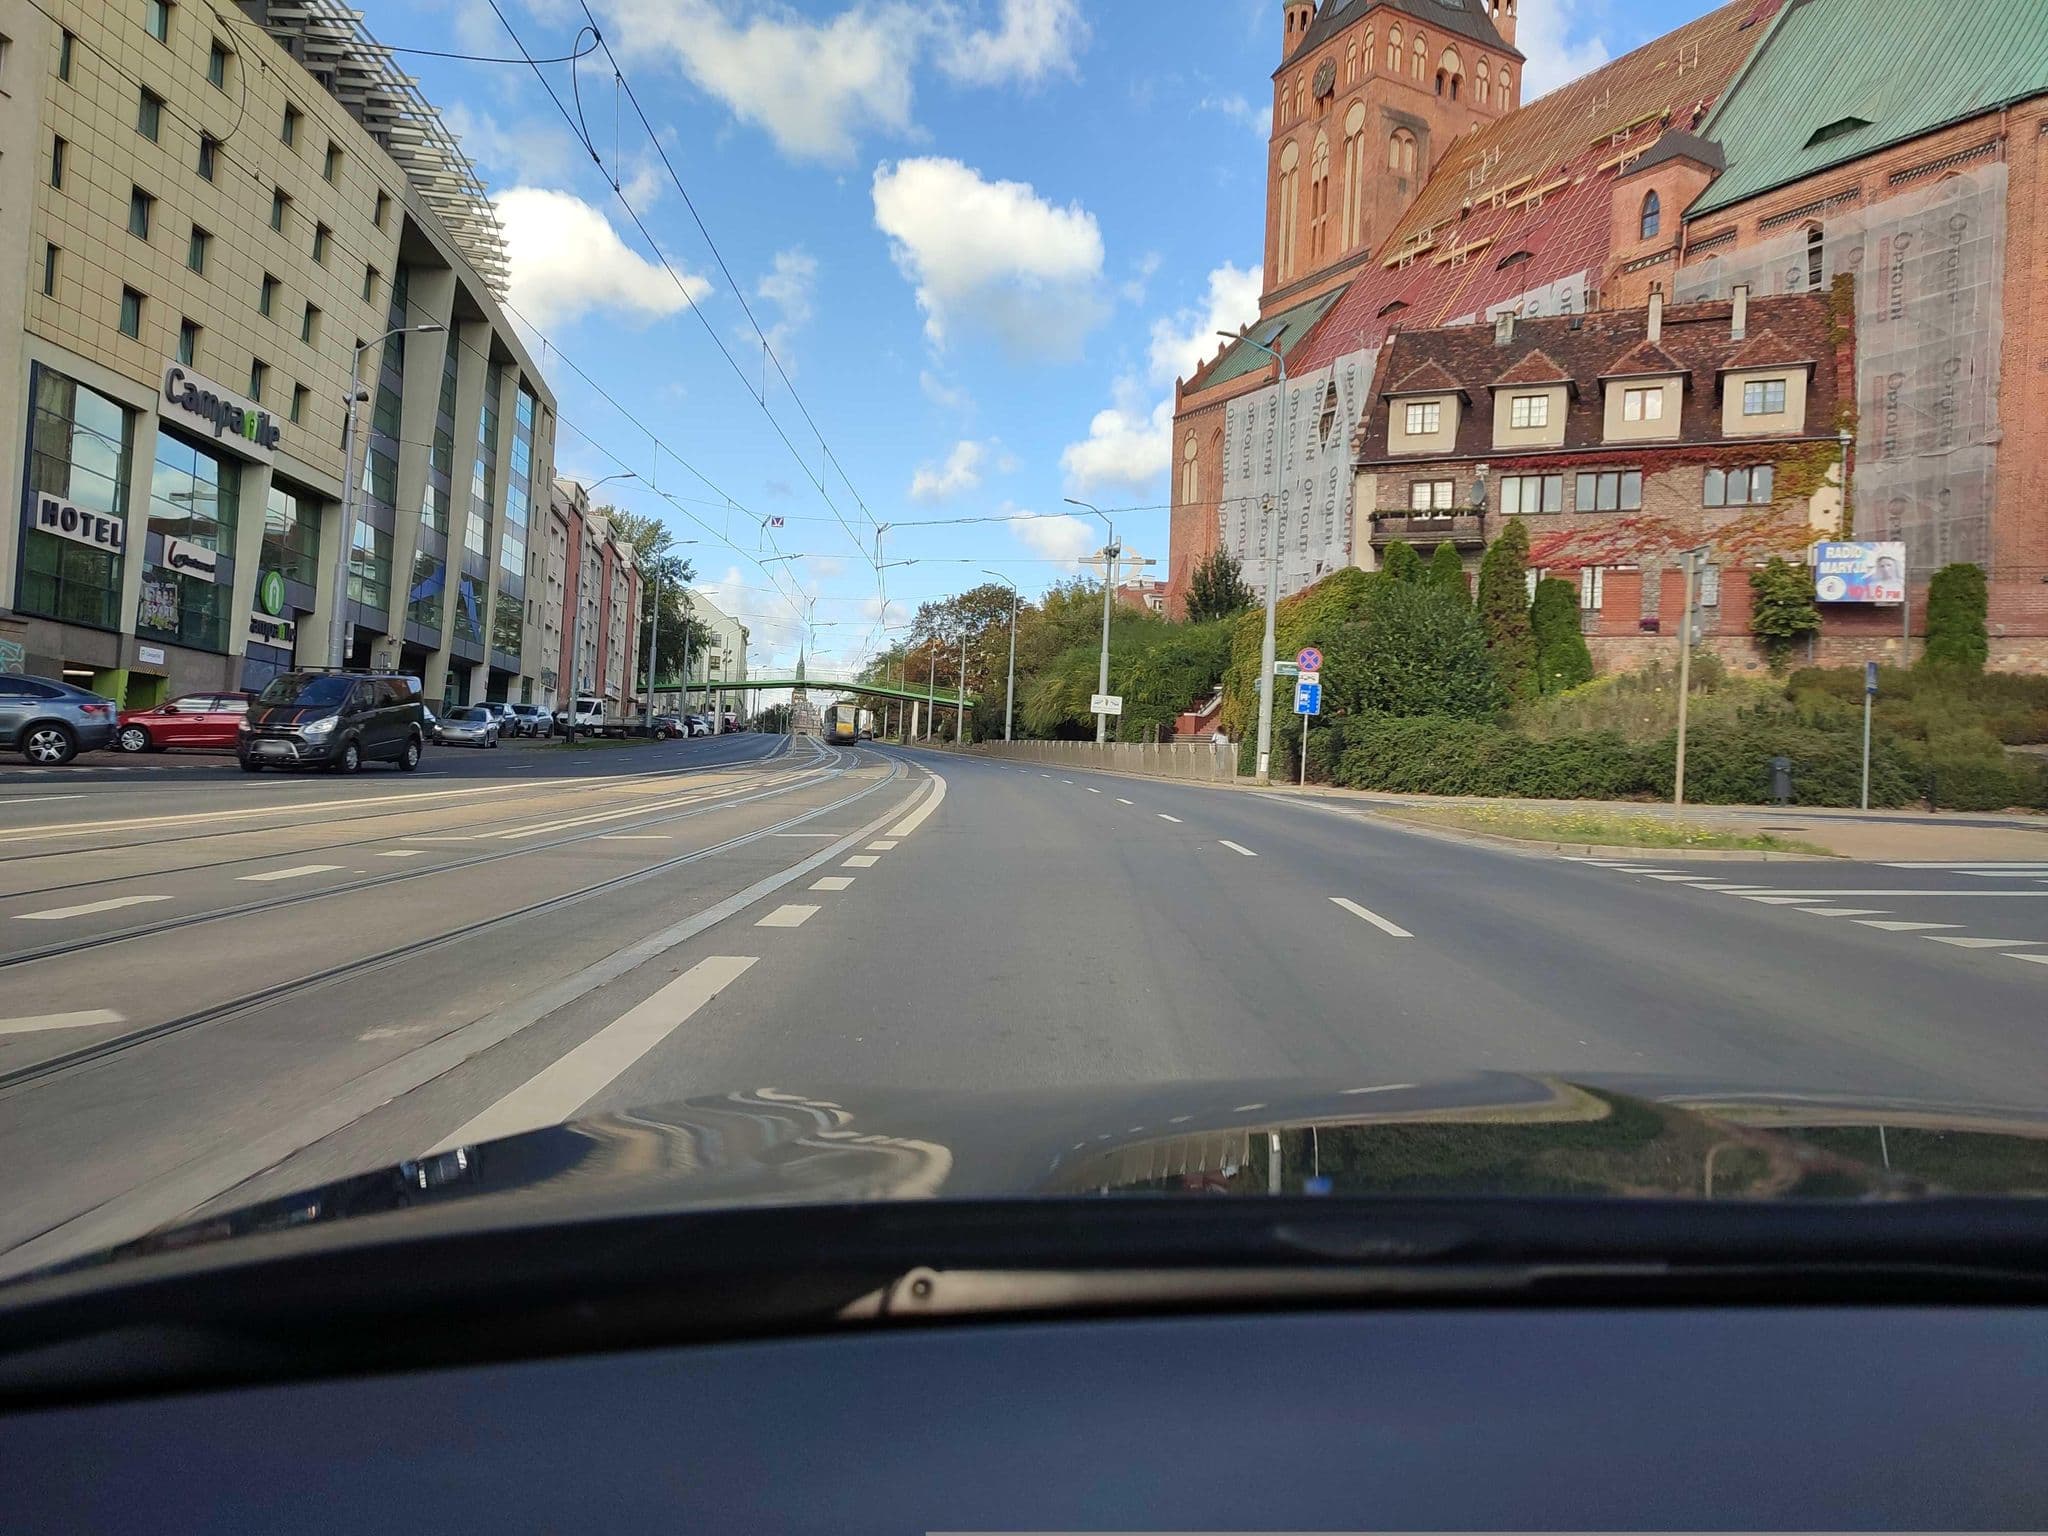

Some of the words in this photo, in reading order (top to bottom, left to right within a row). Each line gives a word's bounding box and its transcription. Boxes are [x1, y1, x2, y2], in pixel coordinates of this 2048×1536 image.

[1891, 231, 1913, 320] OPTOLITH
[165, 367, 280, 451] Campanile
[1242, 401, 1255, 480] OPTOLITH
[1264, 394, 1278, 476] OPTOLITH
[41, 499, 121, 547] HOTEL
[1325, 466, 1338, 546] OPTOLITH
[1820, 561, 1868, 574] MARYJA
[1826, 547, 1862, 559] RADIO
